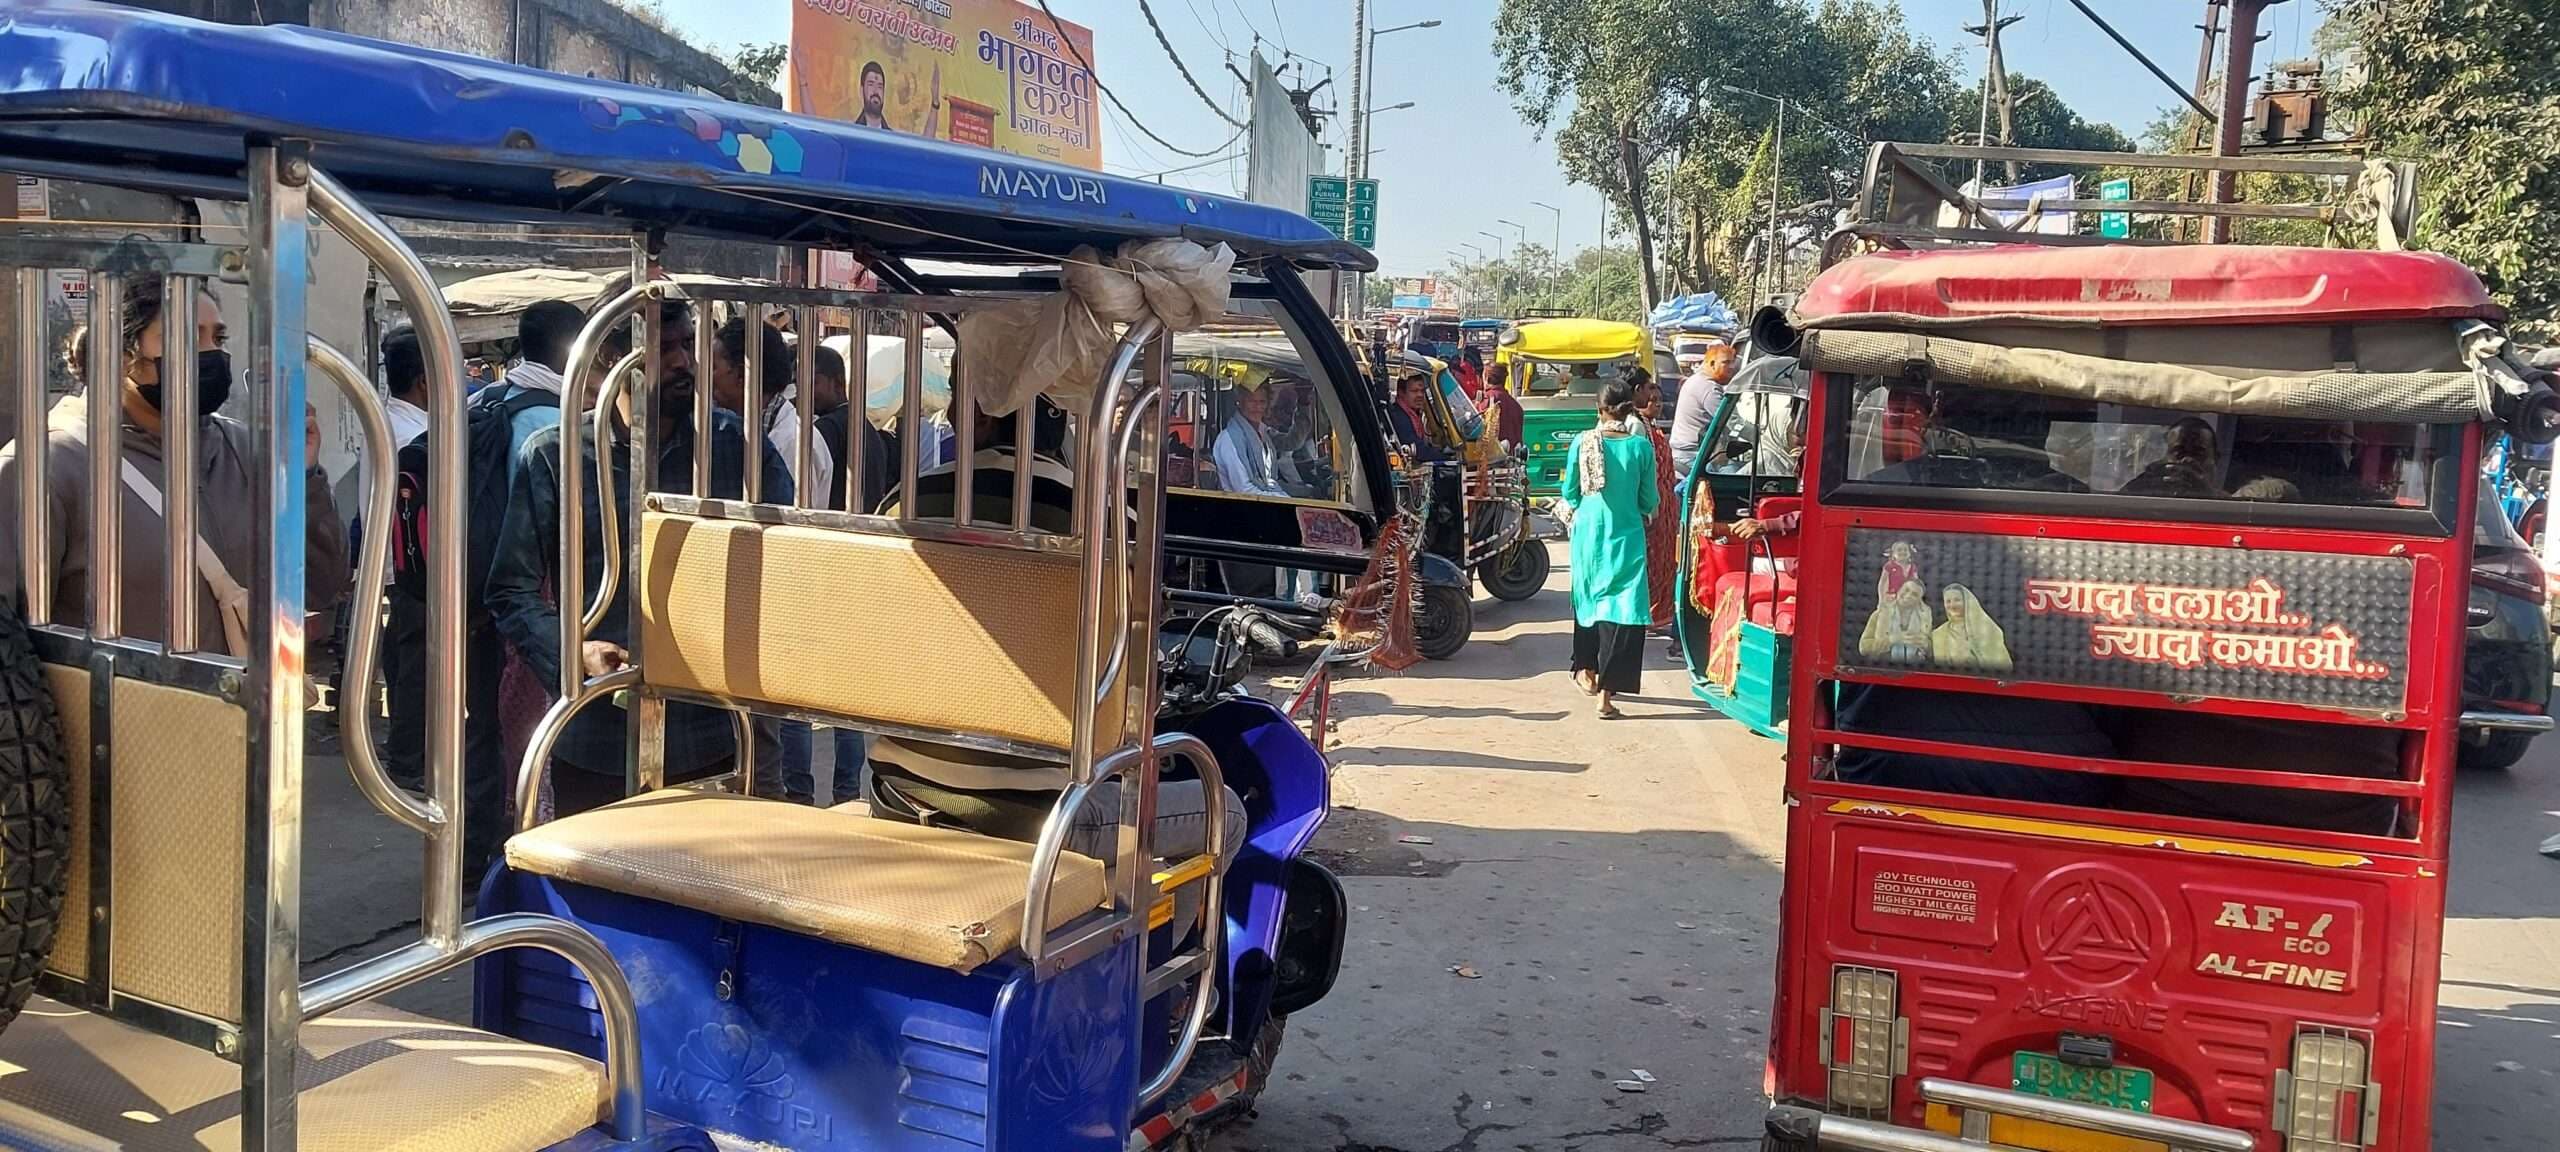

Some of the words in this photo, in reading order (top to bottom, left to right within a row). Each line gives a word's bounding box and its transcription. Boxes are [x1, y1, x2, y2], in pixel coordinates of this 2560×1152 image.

[908, 19, 959, 56] उत्सव
[978, 30, 1091, 130] भागवत
[980, 165, 1107, 205] MAYURI
[2027, 579, 2137, 621] ज्यादा
[2144, 578, 2310, 625] चलाओ...
[2093, 625, 2203, 666] ज्यादा
[2211, 625, 2387, 675] कमाओ...
[1874, 883, 1900, 893] 1200
[1903, 885, 1933, 897] WATT
[1936, 889, 1977, 901] POWER
[1874, 894, 1923, 907] HIGHEST
[1925, 900, 1977, 912] MILEAGE
[1873, 904, 1912, 916] HIGHEST
[1914, 910, 1954, 921] BATTERY
[1955, 915, 1976, 924] LIFE
[2284, 936, 2331, 955] ECO
